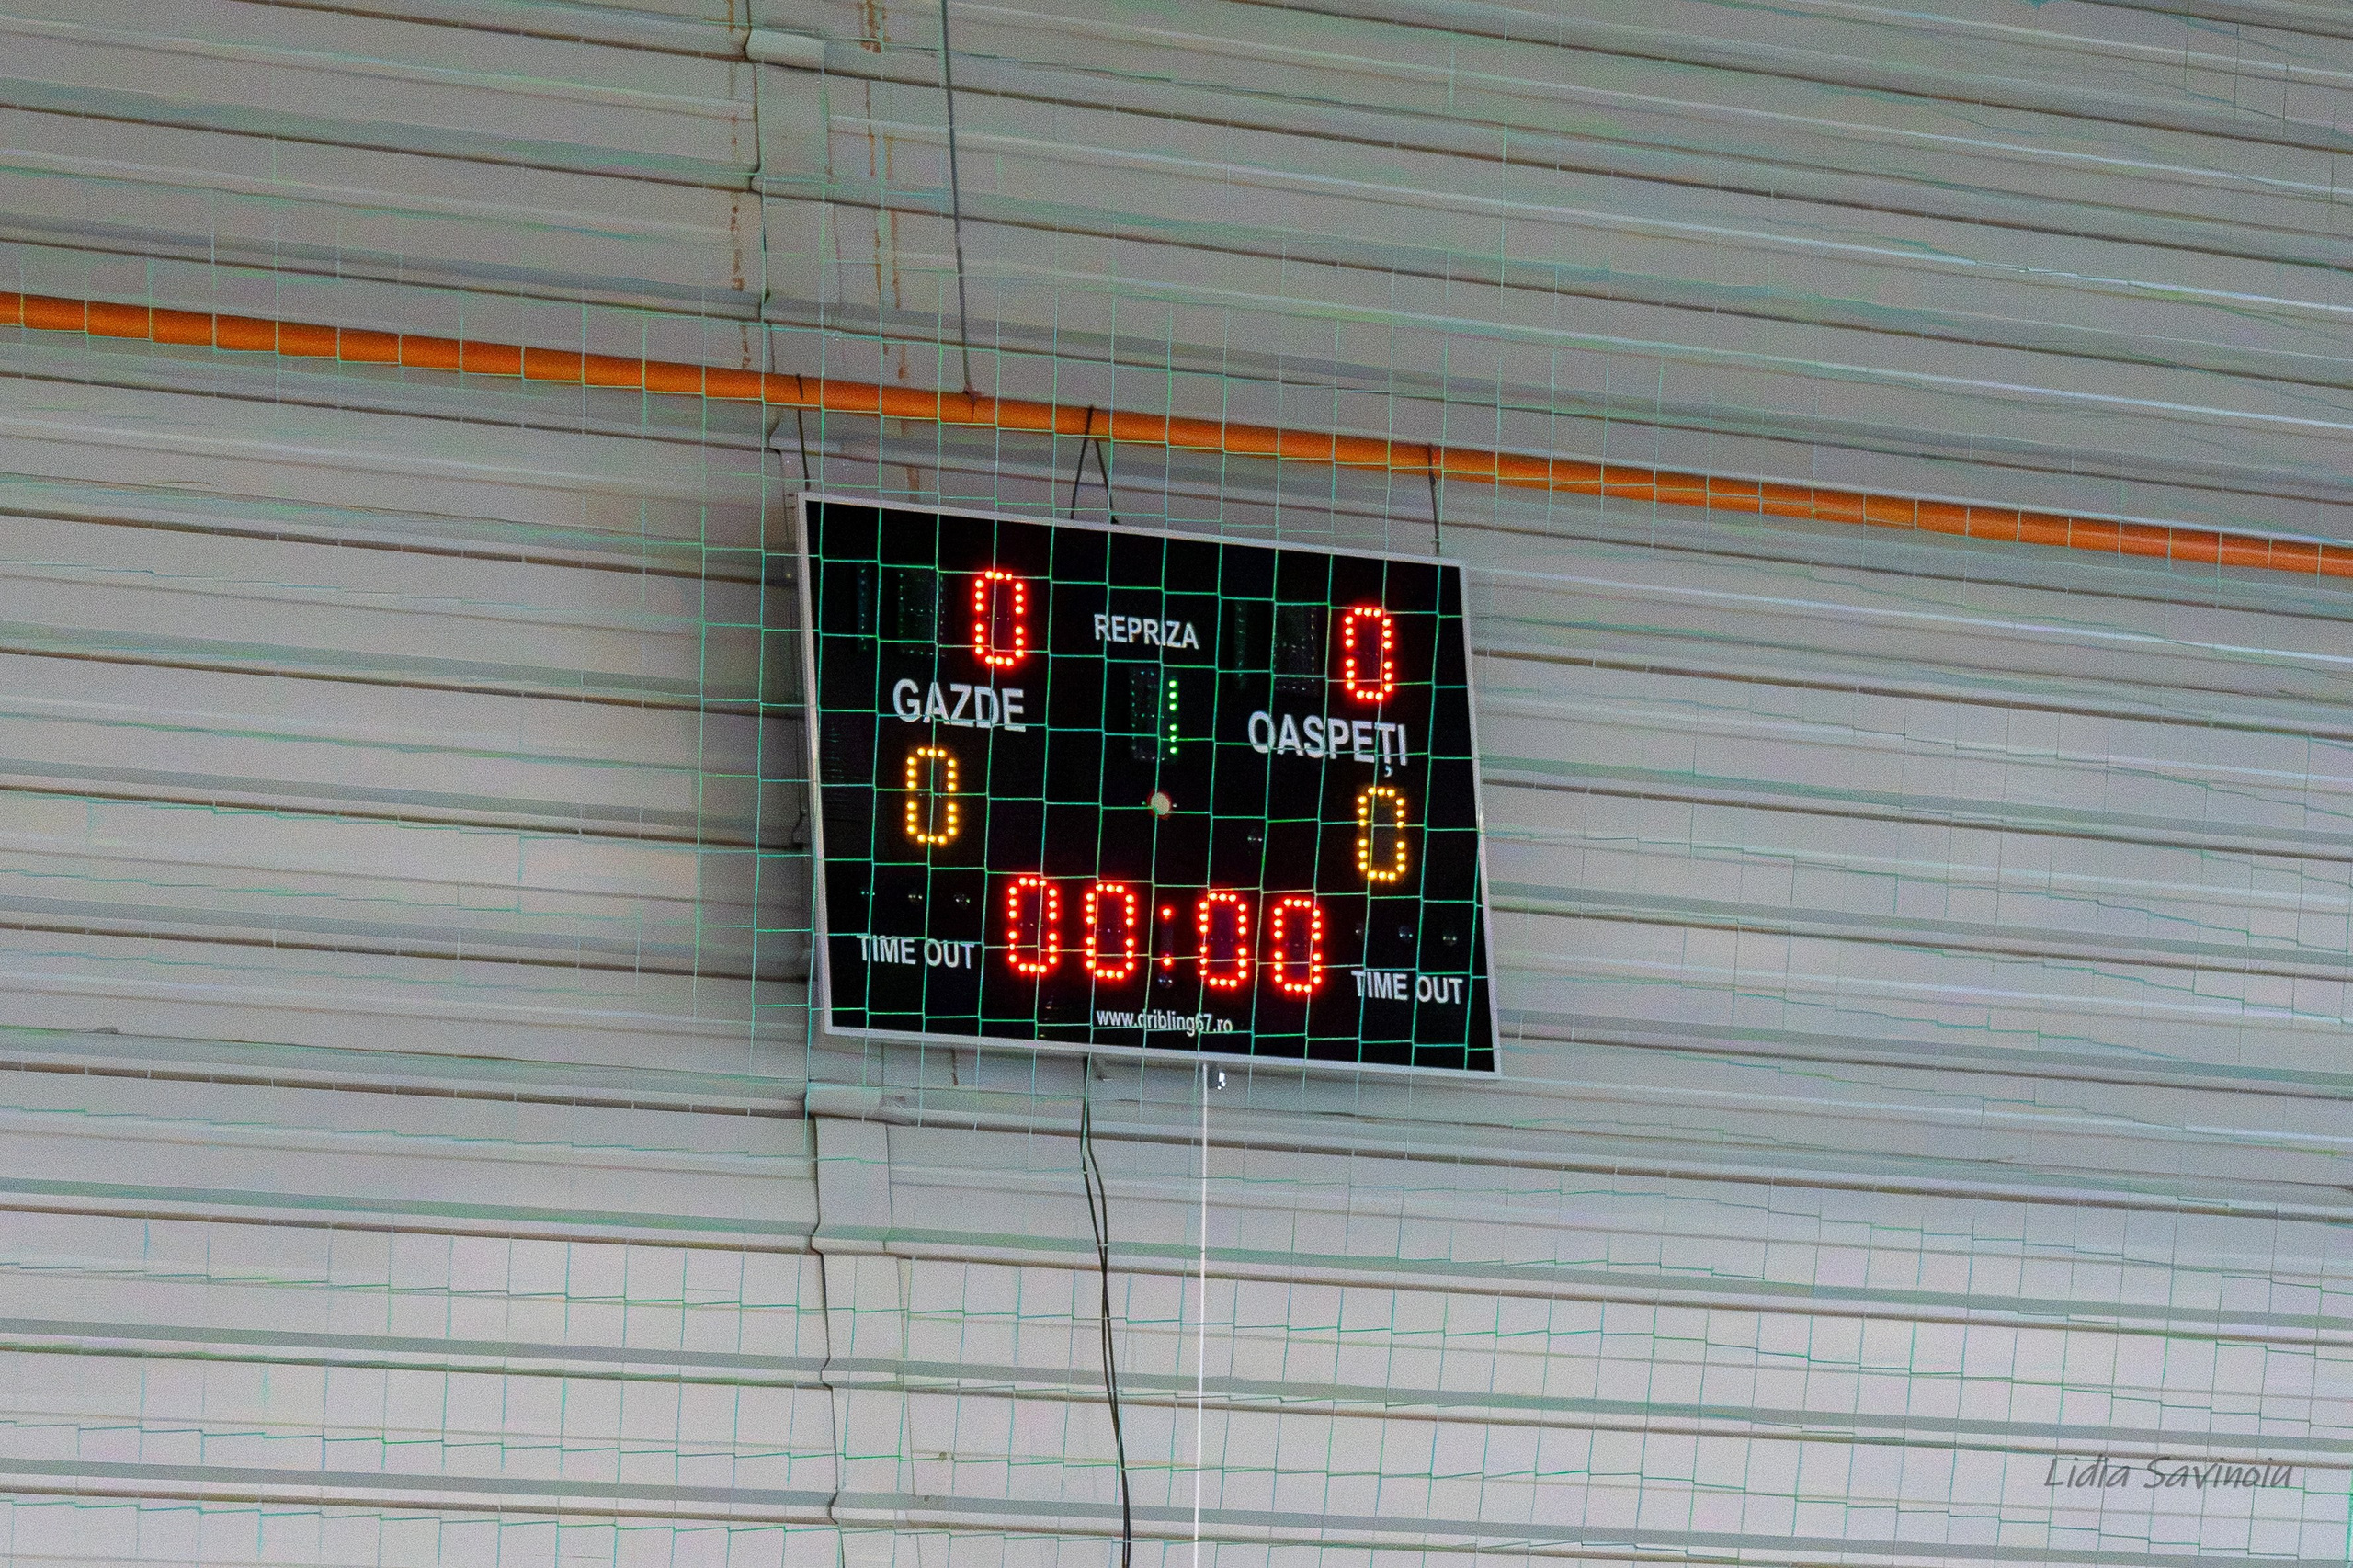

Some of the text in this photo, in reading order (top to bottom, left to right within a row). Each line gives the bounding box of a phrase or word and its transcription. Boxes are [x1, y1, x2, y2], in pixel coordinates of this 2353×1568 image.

[974, 569, 1026, 667] 0
[1094, 613, 1200, 651] REPRIZA
[1342, 606, 1394, 703] 0
[892, 678, 1028, 733] GAZDE
[905, 747, 957, 845] 0
[1356, 786, 1406, 881] 0
[856, 935, 976, 969] TIME OUT
[1007, 876, 1326, 994] 00:00
[1350, 970, 1464, 1005] TIME OUT
